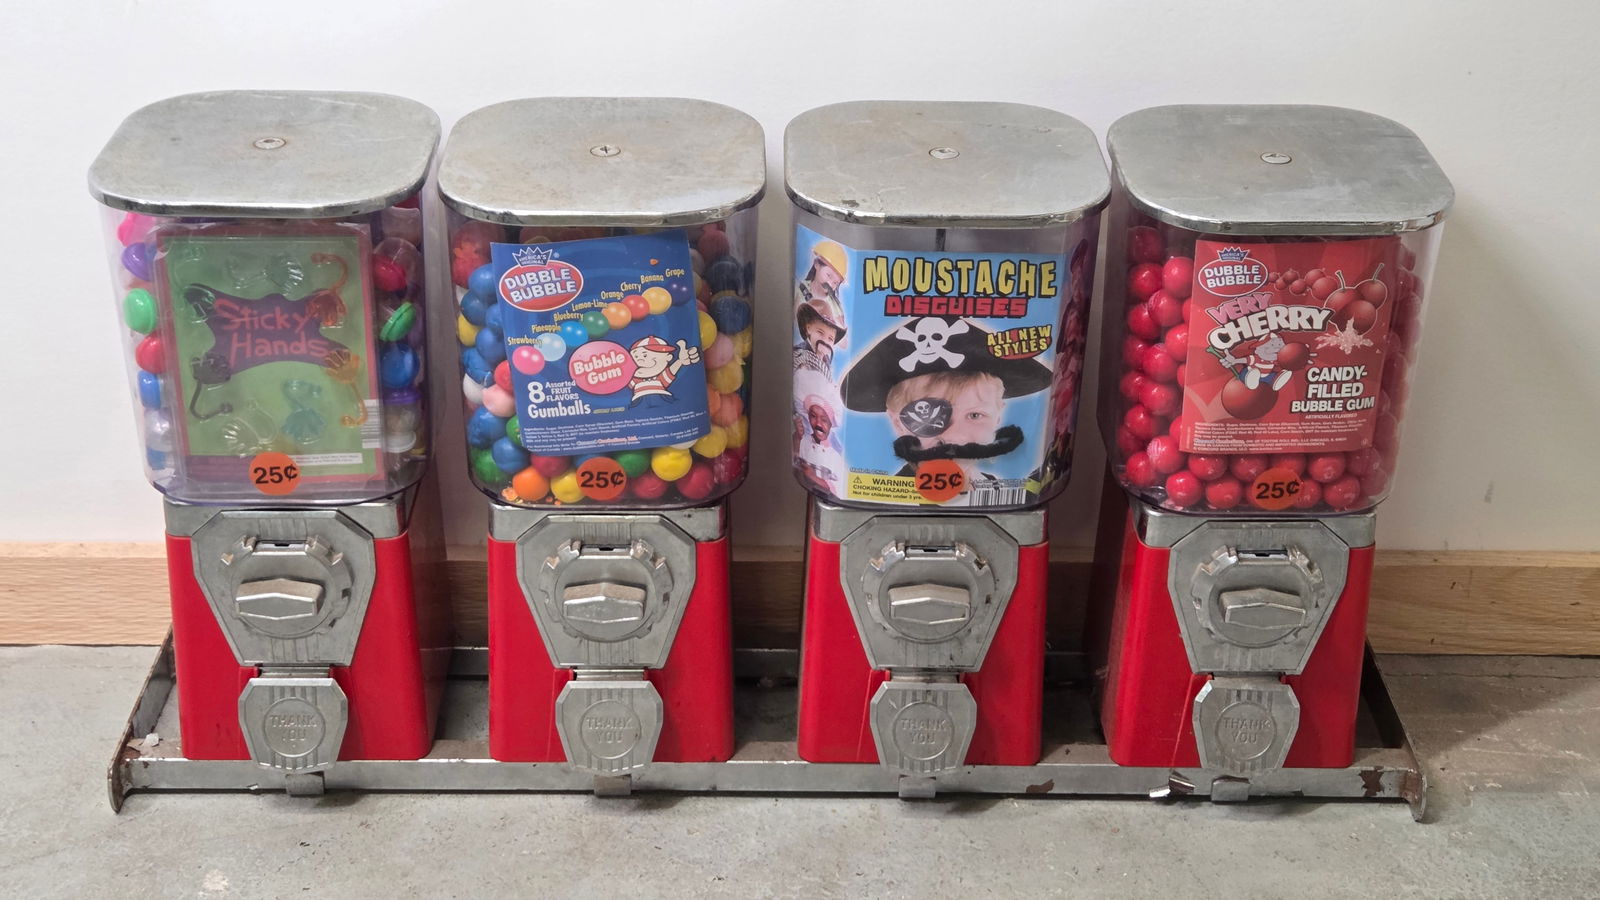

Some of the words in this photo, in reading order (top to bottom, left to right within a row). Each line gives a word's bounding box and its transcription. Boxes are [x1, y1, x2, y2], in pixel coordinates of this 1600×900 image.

[504, 268, 571, 290] DUBBLE
[640, 274, 664, 284] Banana
[665, 268, 685, 278] Grape
[863, 255, 1057, 298] MOUSTACHE
[1204, 264, 1260, 279] DUBBLE
[620, 281, 641, 292] Cherry
[1206, 275, 1262, 289] BUBBLE
[510, 281, 576, 302] BUBBLE
[600, 291, 624, 300] Orange
[571, 299, 608, 311] Lemon-Lime
[884, 295, 1029, 318] DISGUISES
[1206, 292, 1273, 325] VERY
[213, 298, 311, 333] Sticky
[553, 310, 584, 322] Blueberry
[531, 322, 561, 334] Pineapple
[987, 331, 1012, 346] ALL
[1018, 325, 1051, 340] NEW
[1208, 305, 1335, 350] CHERRY
[507, 335, 544, 346] Strawberry
[993, 338, 1048, 357] STYLES
[228, 332, 330, 368] Hands
[572, 351, 625, 376] Bubble
[587, 367, 622, 385] Gum
[1307, 366, 1368, 382] CANDY-
[527, 381, 546, 404] 8
[545, 380, 576, 389] Assorted
[551, 386, 572, 395] FRUIT
[1307, 382, 1364, 399] FILLED
[546, 393, 580, 402] FLAVORS
[1291, 400, 1343, 413] BUBBLE
[1346, 397, 1375, 411] GUM
[527, 401, 591, 419] Gumballs
[253, 464, 298, 485] 25¢
[580, 470, 625, 488] 25¢
[919, 472, 963, 491] 25¢
[853, 484, 882, 492] CHOKING
[872, 478, 915, 488] WARNING
[1256, 480, 1300, 500] 25¢
[269, 714, 317, 728] THANK
[586, 717, 634, 730] THANK
[900, 718, 947, 731] THANK
[1223, 716, 1271, 731] THANK
